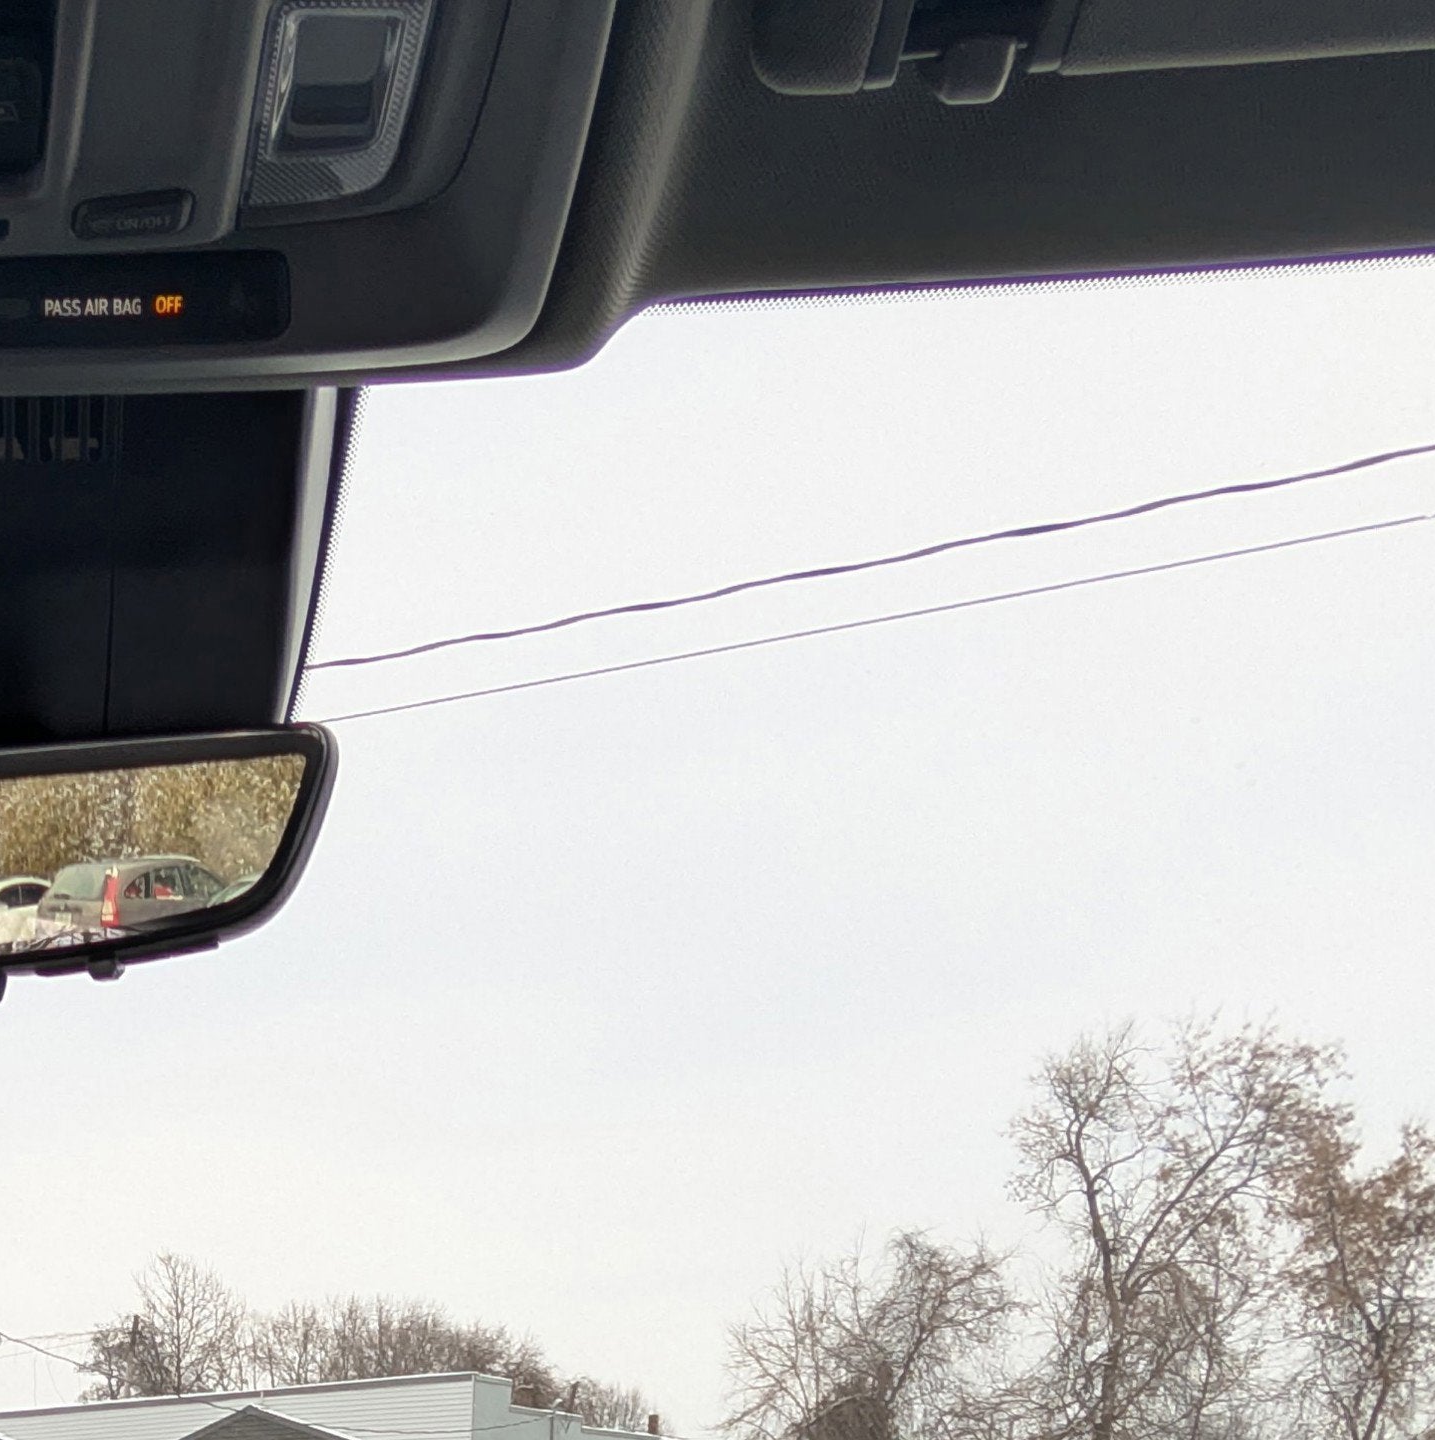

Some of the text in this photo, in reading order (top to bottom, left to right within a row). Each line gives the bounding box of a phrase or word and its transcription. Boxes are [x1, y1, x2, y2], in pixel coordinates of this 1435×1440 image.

[44, 298, 142, 317] PASS AIR BAG
[155, 295, 183, 315] OFF
